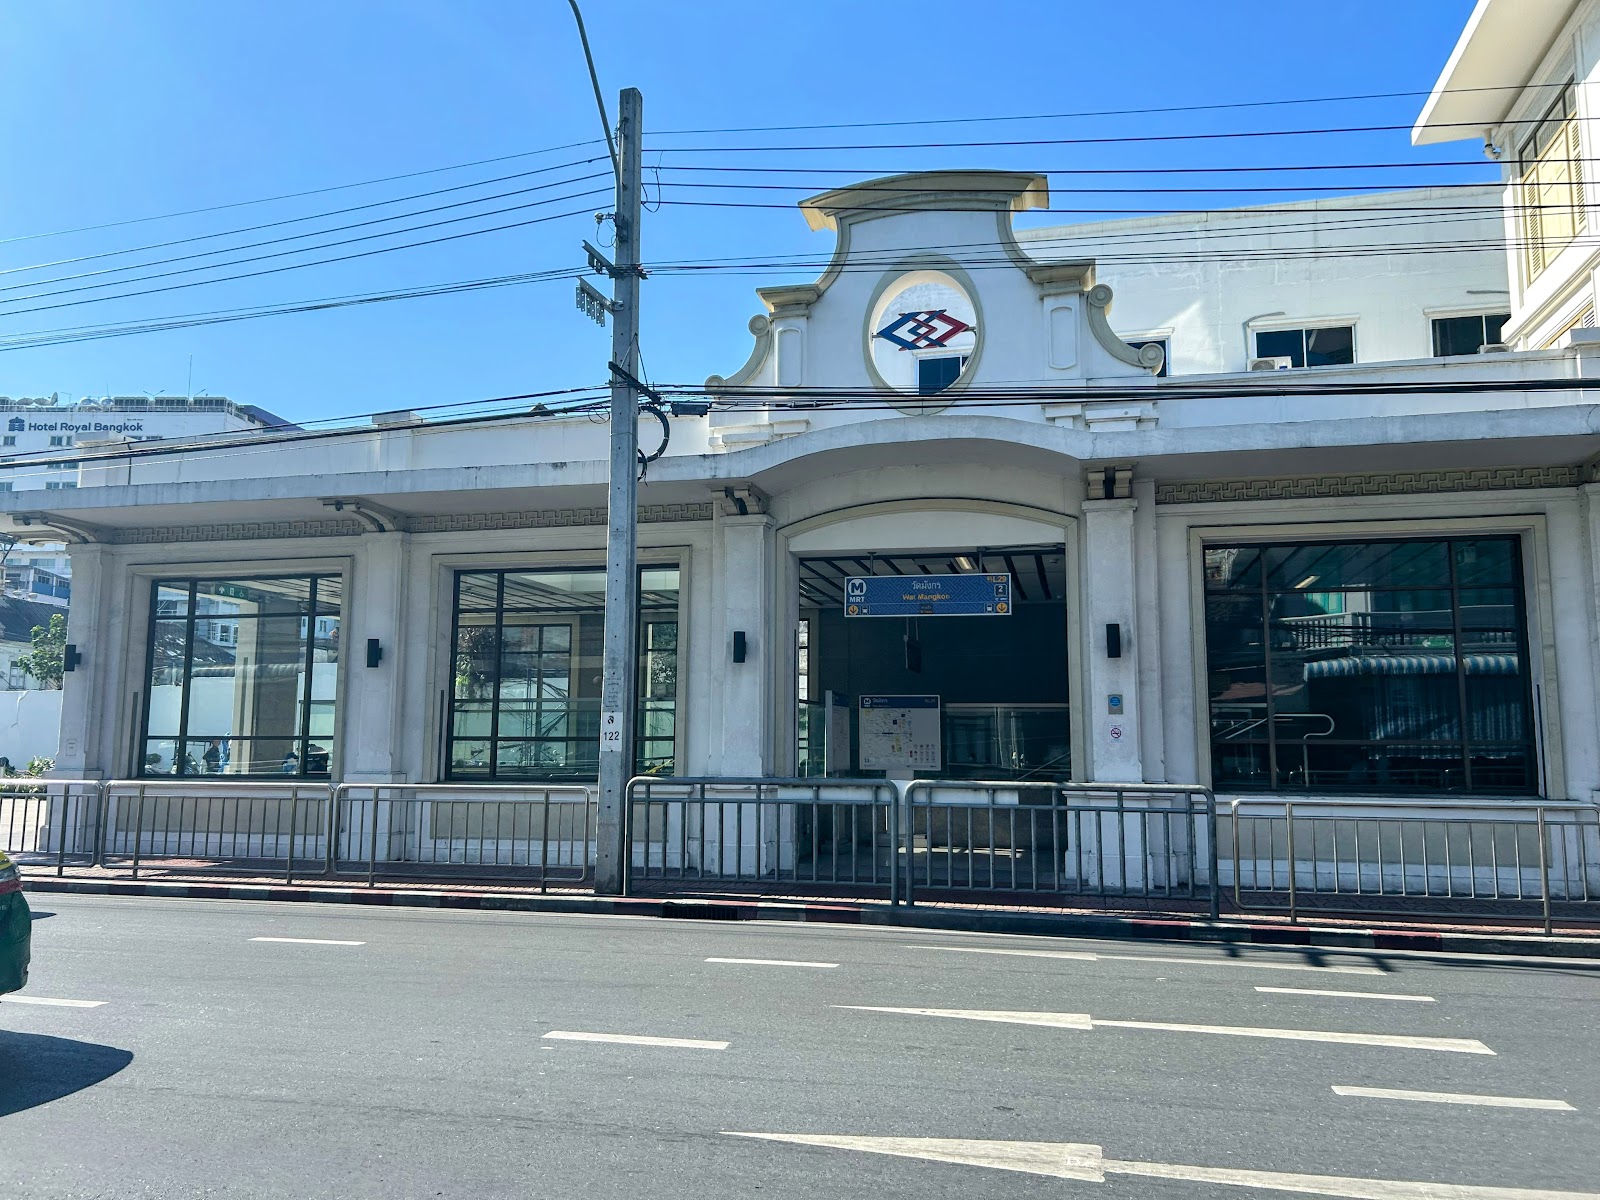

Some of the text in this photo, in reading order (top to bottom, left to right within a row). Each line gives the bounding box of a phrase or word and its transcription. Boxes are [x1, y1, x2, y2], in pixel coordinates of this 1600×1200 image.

[28, 422, 143, 433] Hotel Royal Bangkok
[917, 593, 950, 601] Mangkon
[604, 731, 619, 740] 122
